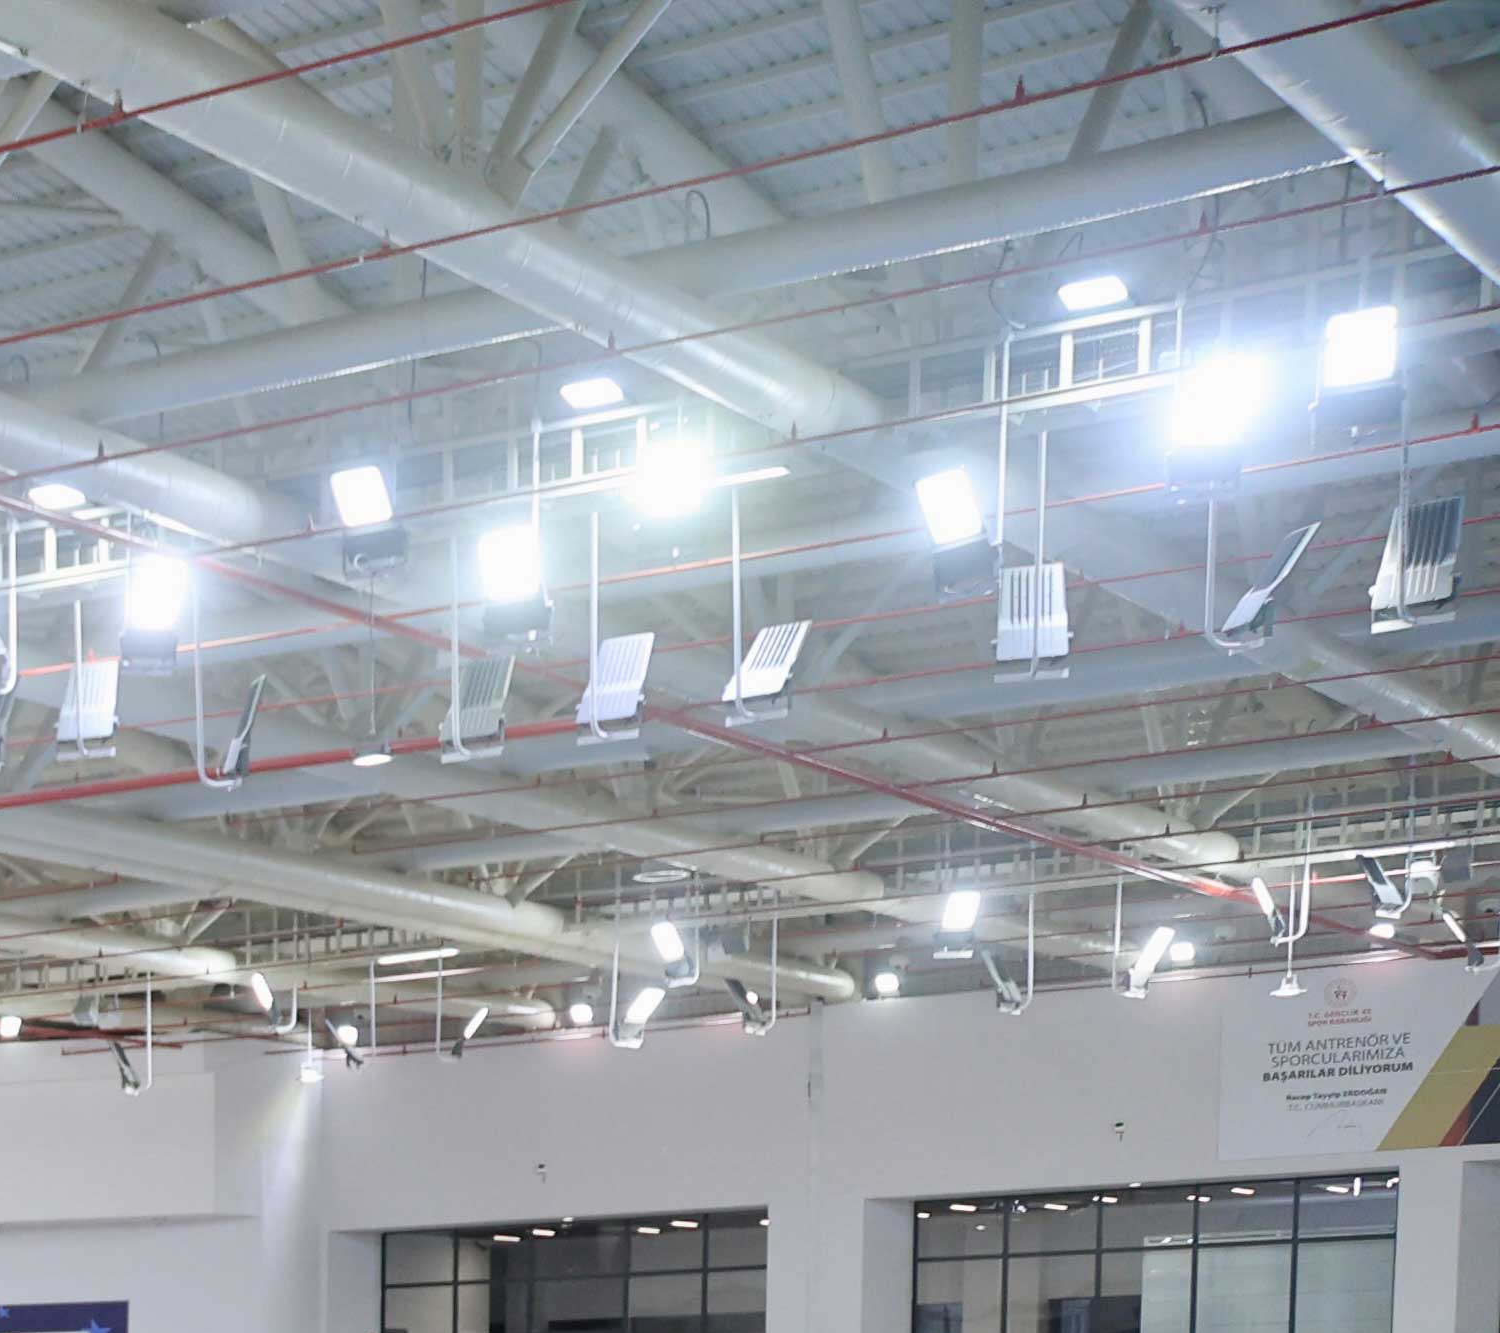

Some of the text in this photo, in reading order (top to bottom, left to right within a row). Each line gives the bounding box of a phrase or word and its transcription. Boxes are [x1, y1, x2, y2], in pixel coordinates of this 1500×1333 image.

[1268, 1032, 1411, 1055] TÜM ANTRENÖR VE
[1271, 1047, 1405, 1068] SPORCULARIMIZA
[1262, 1061, 1414, 1083] BAŞARILAR DİLİYORUM
